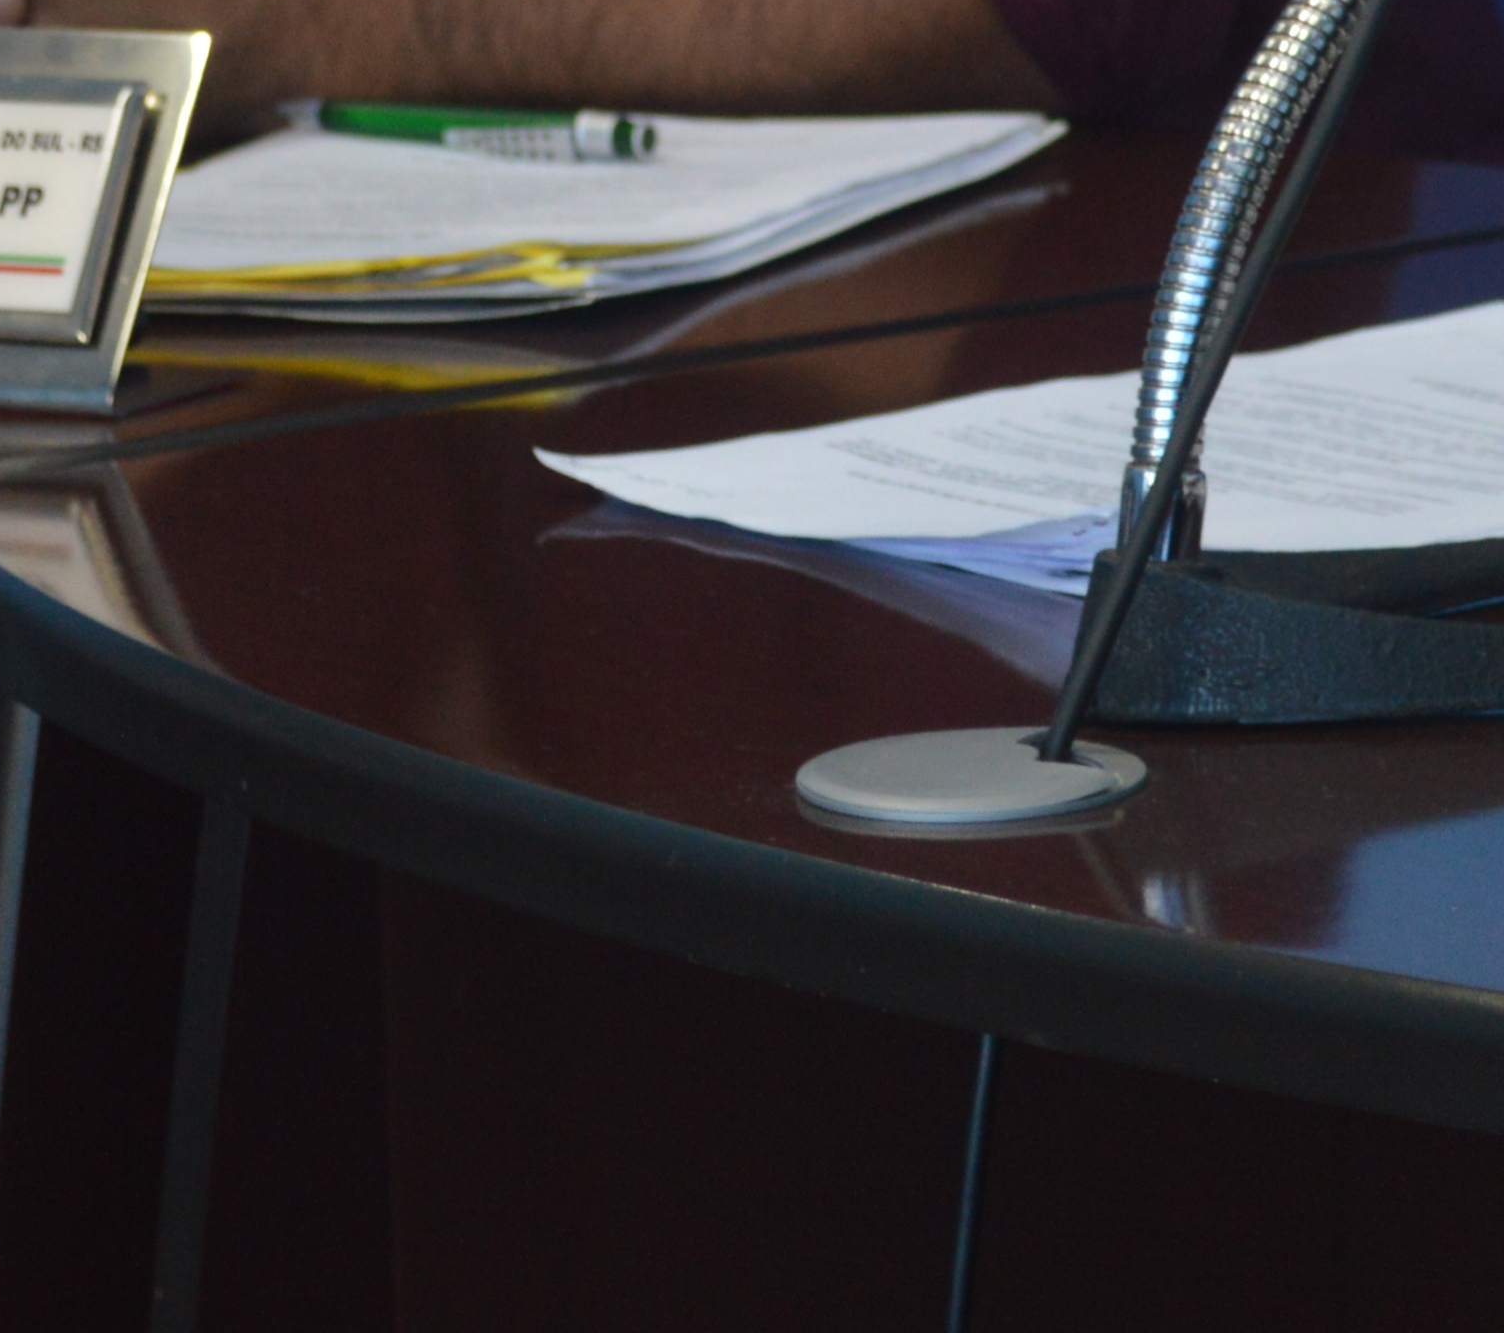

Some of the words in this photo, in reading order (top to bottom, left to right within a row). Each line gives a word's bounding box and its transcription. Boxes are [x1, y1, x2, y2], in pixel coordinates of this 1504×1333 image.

[1, 130, 27, 150] DO
[30, 131, 63, 152] SUL
[80, 133, 104, 153] RS
